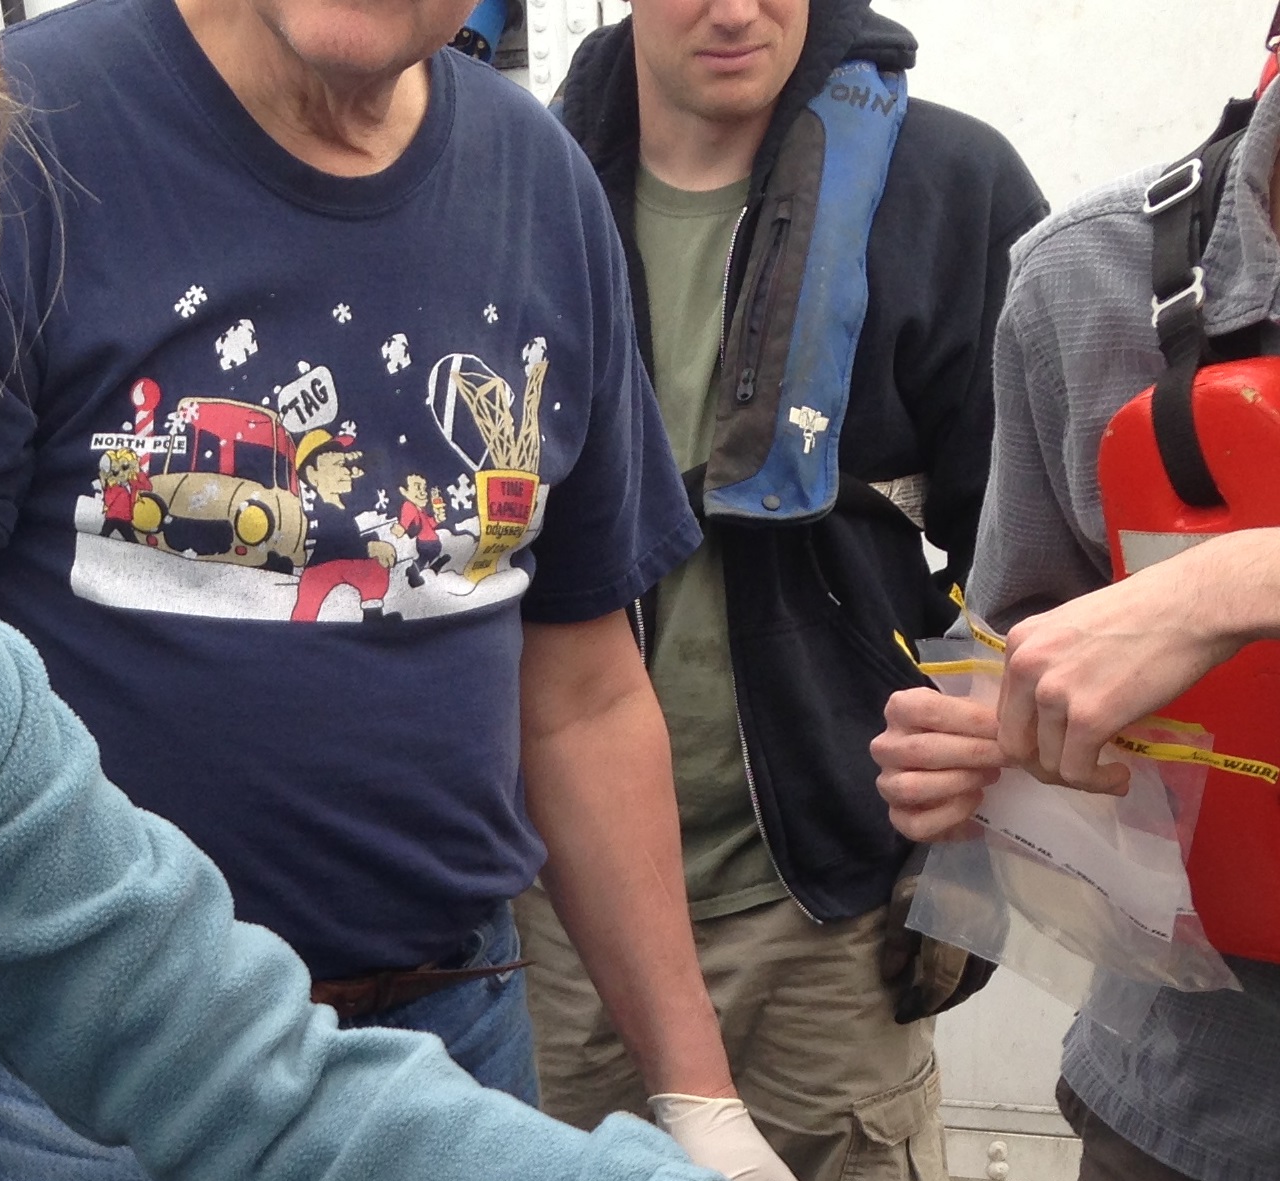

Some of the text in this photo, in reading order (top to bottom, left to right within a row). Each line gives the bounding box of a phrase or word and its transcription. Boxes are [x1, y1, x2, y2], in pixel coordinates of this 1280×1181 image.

[830, 82, 899, 118] OHN
[283, 377, 329, 425] TAG
[93, 436, 146, 449] NORTH
